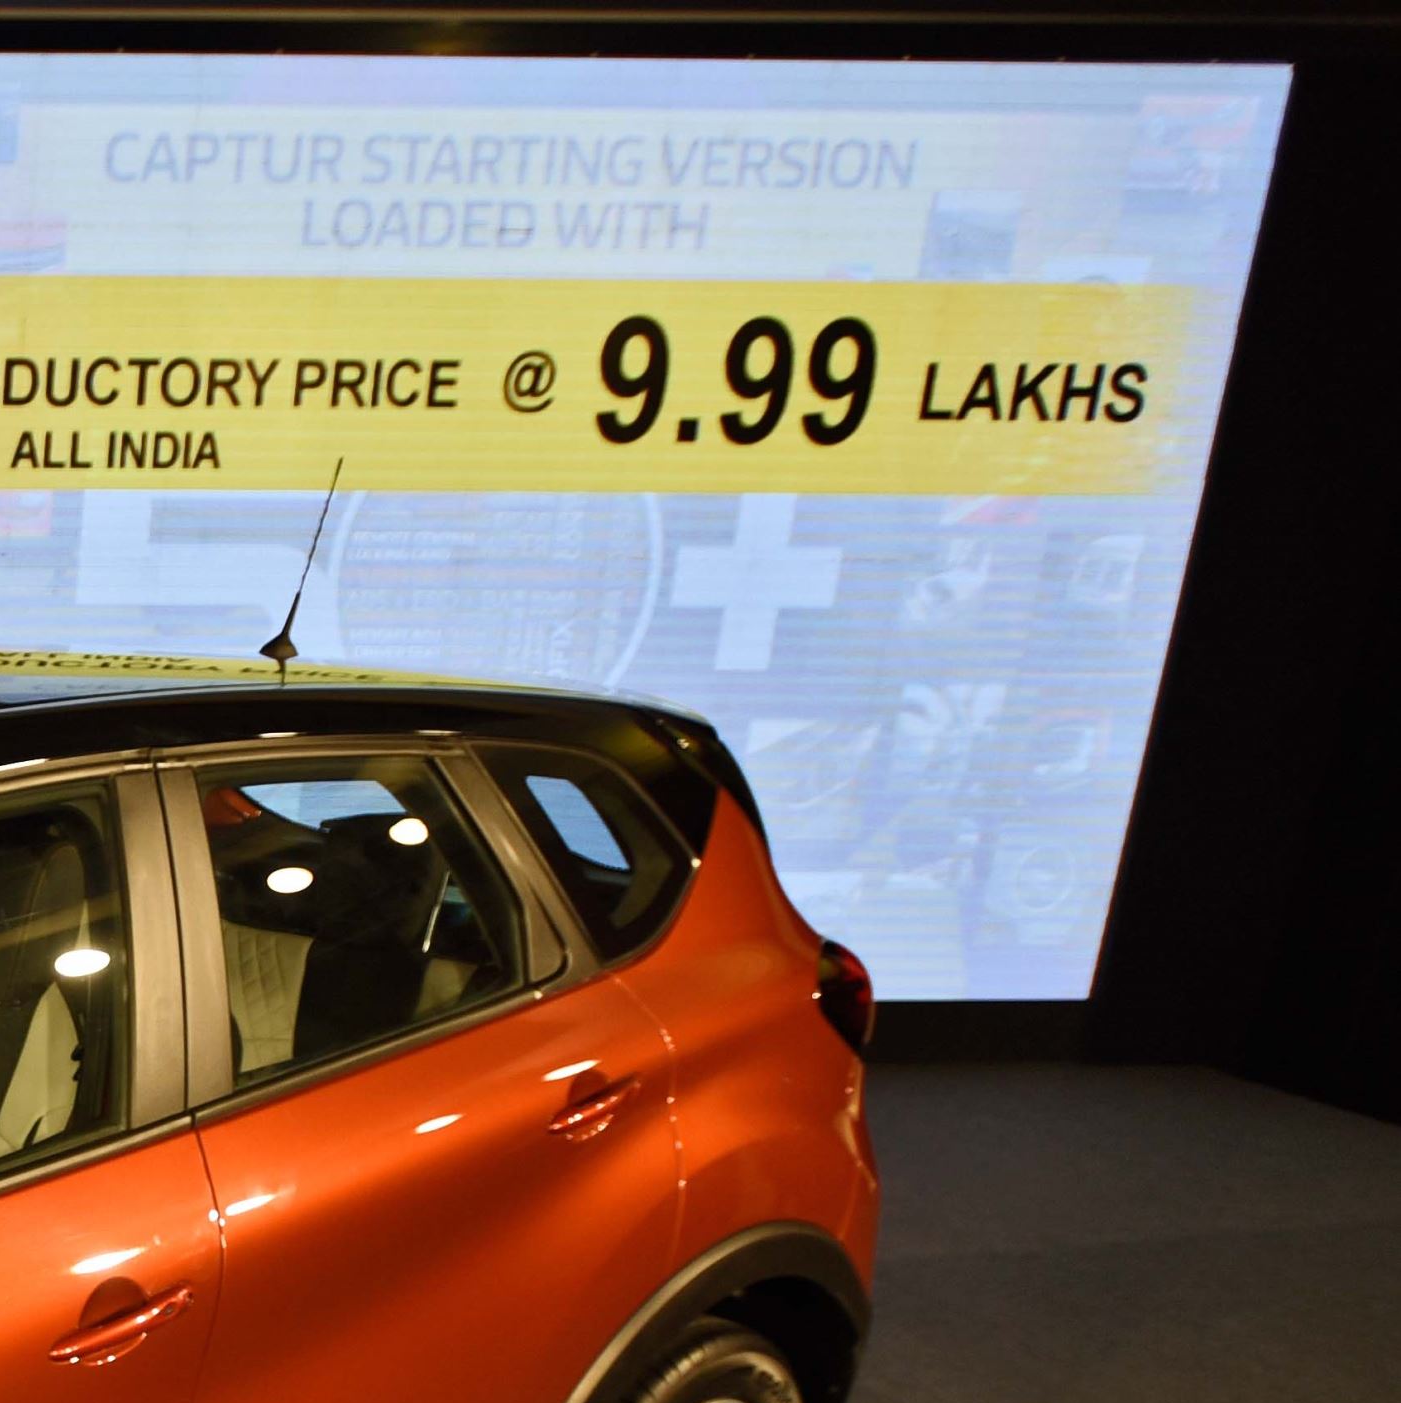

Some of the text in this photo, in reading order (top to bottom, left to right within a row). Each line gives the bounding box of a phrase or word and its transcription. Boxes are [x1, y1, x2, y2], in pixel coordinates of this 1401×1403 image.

[104, 132, 919, 189] CAPTUR STARTING VERSION
[301, 199, 711, 250] LOADED WITH
[293, 359, 461, 408] PRICE
[502, 350, 557, 413] @
[596, 315, 878, 446] 9.99
[918, 361, 1149, 423] LAKHS
[10, 431, 221, 469] ALL INDIA
